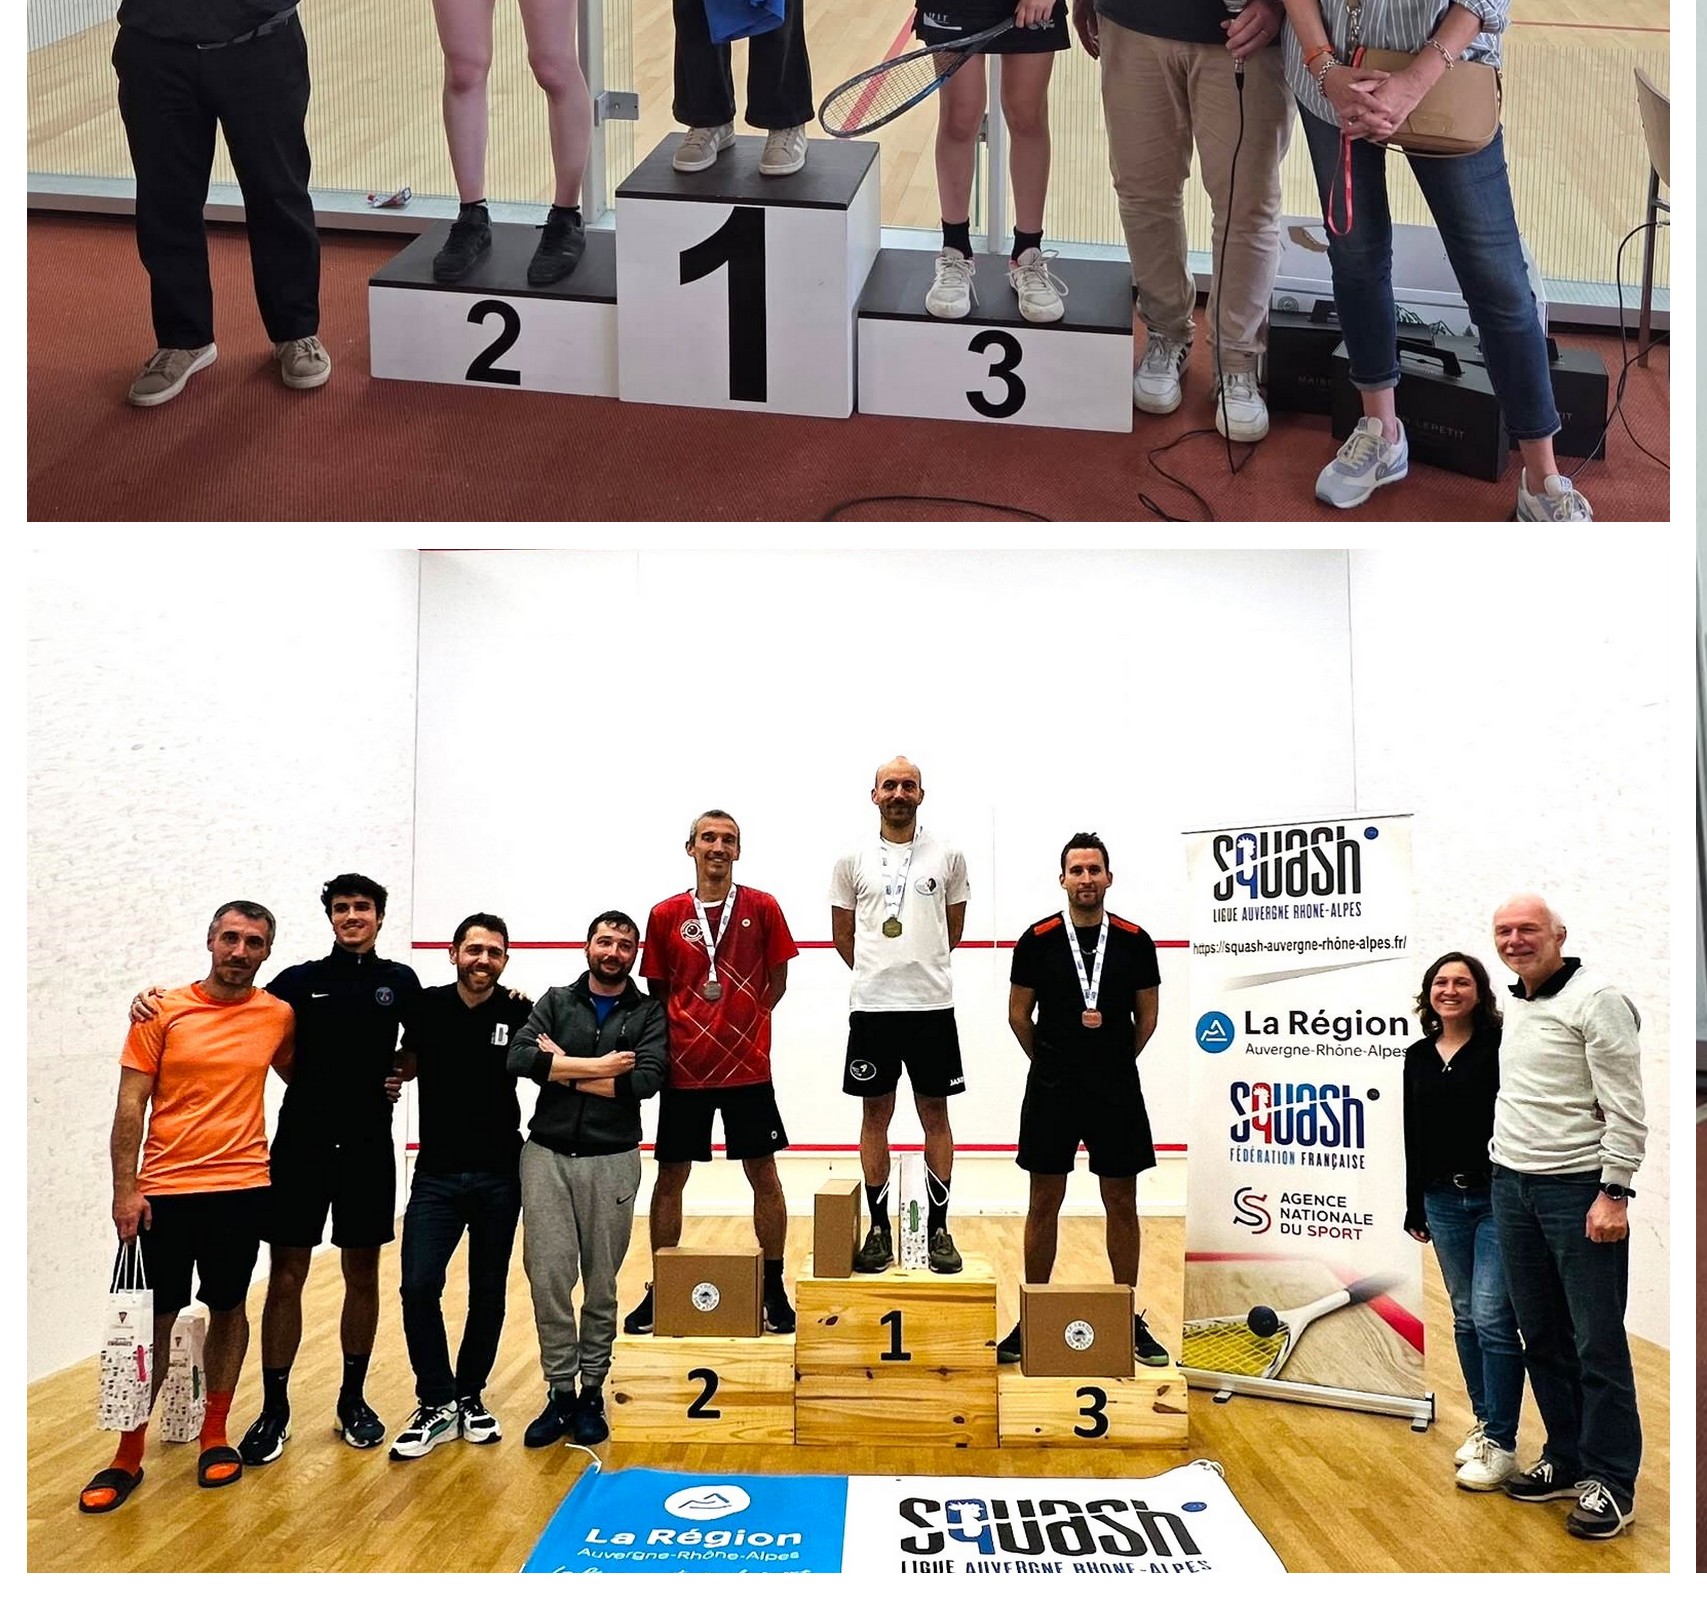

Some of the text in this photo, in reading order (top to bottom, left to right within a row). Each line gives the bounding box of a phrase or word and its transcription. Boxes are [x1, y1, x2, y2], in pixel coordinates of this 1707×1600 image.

[680, 205, 768, 404] 1
[465, 299, 523, 387] 2
[965, 330, 1026, 418] 3
[1213, 901, 1362, 923] LIGUE AUVERGNE RHONE-ALPES
[1244, 1009, 1409, 1042] La Région
[1245, 1042, 1409, 1059] Auvergne-Rhône-Alpes
[1229, 1145, 1365, 1171] FÉDÉRATION FRANÇAISE
[1280, 1192, 1347, 1208] AGENCE
[1280, 1208, 1374, 1226] NATIONALE
[1280, 1223, 1363, 1241] DU SPORT
[879, 1309, 912, 1363] 1
[686, 1368, 722, 1421] 2
[1073, 1386, 1110, 1440] 3
[585, 1527, 802, 1549] La Région
[577, 1547, 801, 1563] Auvergne-Rhône-Alpes
